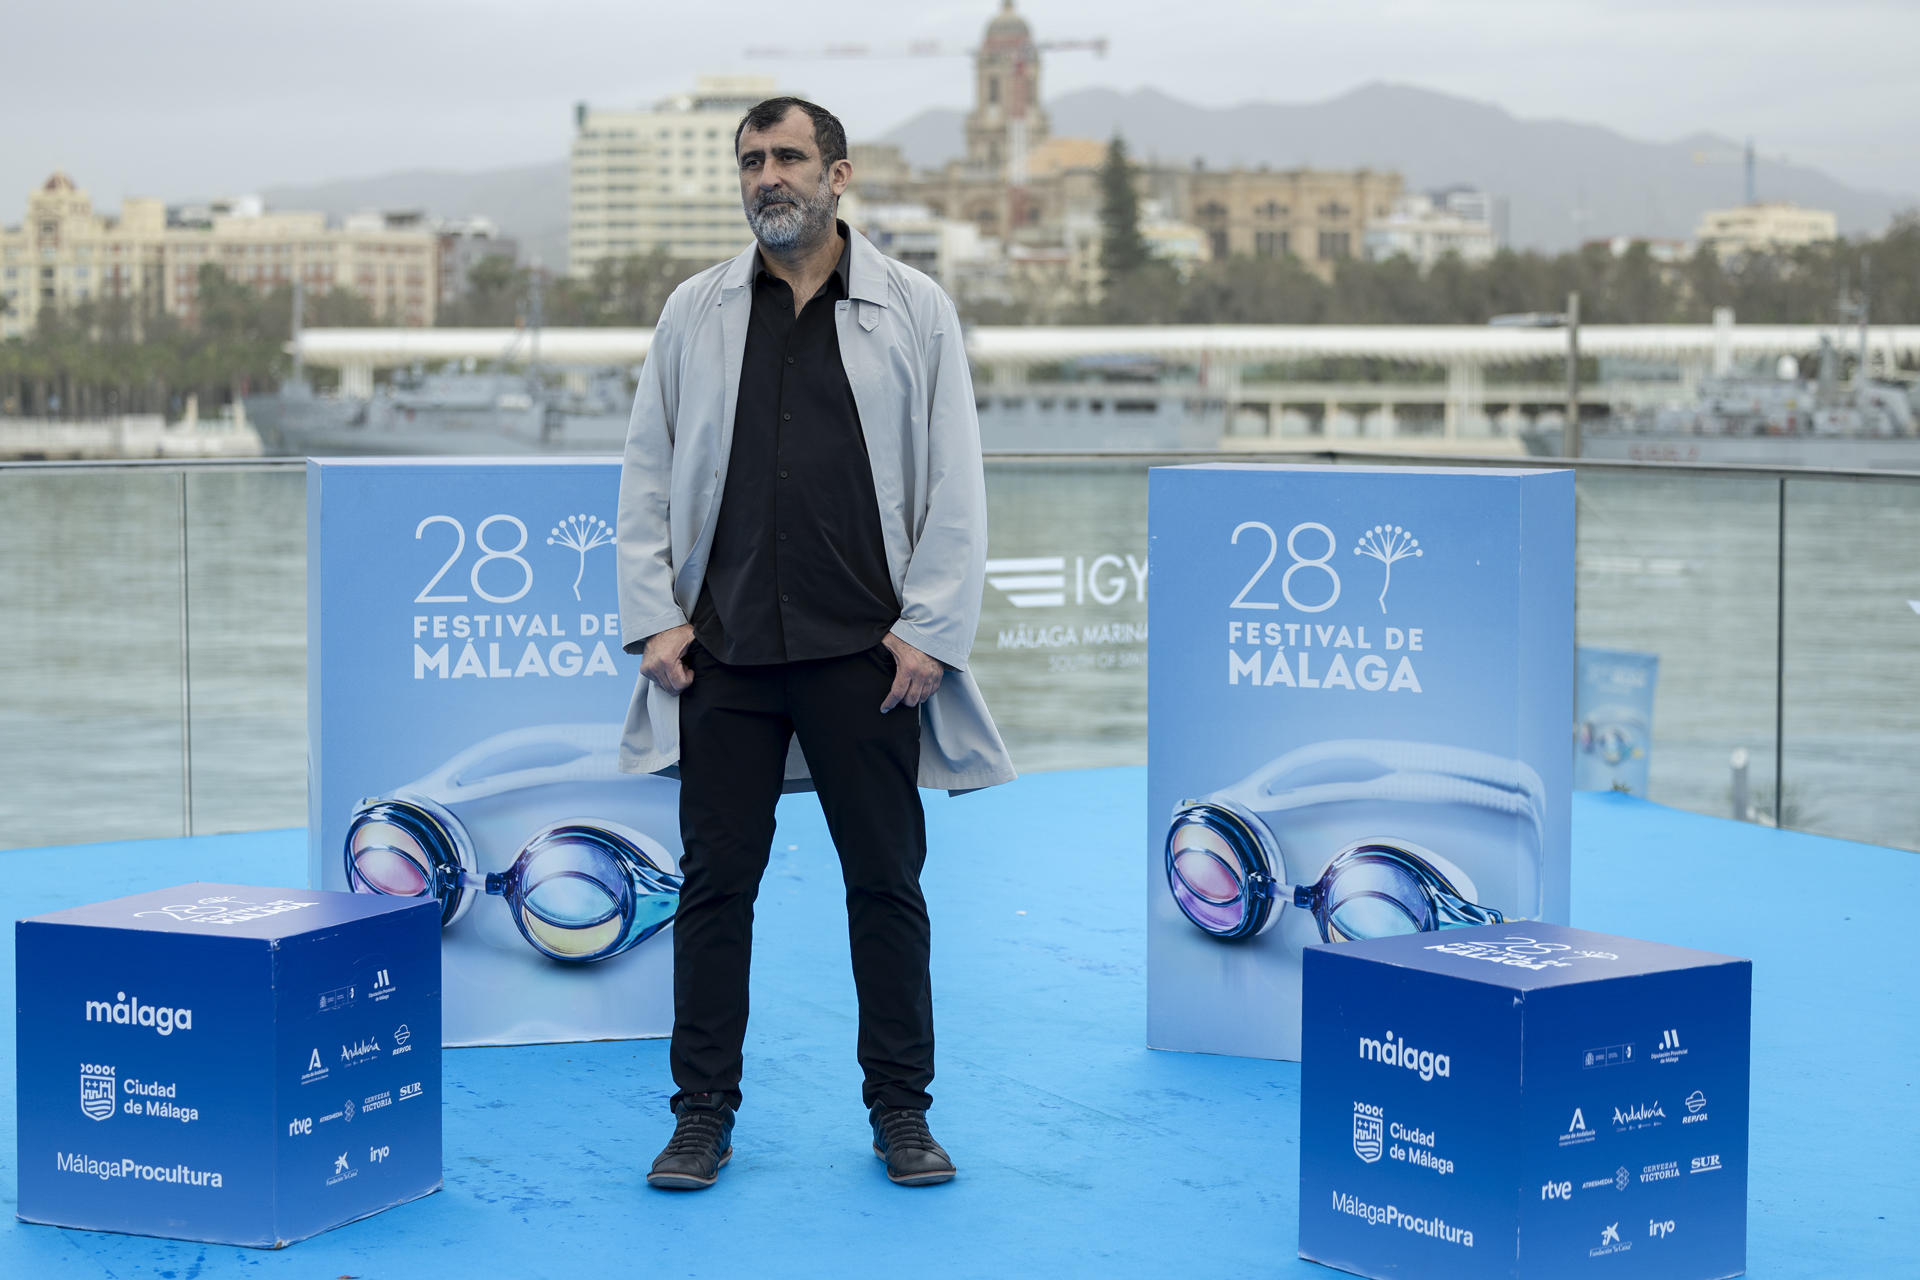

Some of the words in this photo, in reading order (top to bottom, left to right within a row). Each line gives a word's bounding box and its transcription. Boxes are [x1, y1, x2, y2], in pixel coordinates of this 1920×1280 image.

[414, 514, 533, 603] 28
[1229, 521, 1341, 613] 28
[1075, 554, 1148, 605] IGY
[414, 614, 566, 638] FESTIVAL
[580, 613, 619, 636] DE
[1229, 621, 1371, 649] FESTIVAL
[1385, 628, 1424, 651] DE
[414, 637, 619, 680] MÁLAGA
[1229, 646, 1423, 693] MÁLAGA
[123, 1079, 176, 1098] Ciudad
[399, 1082, 421, 1097] SUR
[123, 1099, 142, 1115] de
[146, 1100, 199, 1123] Málaga
[362, 1097, 392, 1113] VICTORIA
[289, 1117, 312, 1136] rtve
[1682, 1113, 1708, 1124] REPSOL
[1389, 1122, 1435, 1147] Ciudad
[370, 1146, 390, 1164] iryo
[1389, 1144, 1406, 1160] de
[1408, 1147, 1454, 1174] Málaga
[1643, 1160, 1678, 1173] CERVEZAS
[1691, 1154, 1720, 1169] SUR
[57, 1151, 223, 1188] MálagaProcultura
[1640, 1168, 1680, 1184] VICTORIA
[1542, 1180, 1572, 1200] rtve
[1332, 1190, 1474, 1248] MálagaProcultura
[1649, 1219, 1675, 1239] iryo
